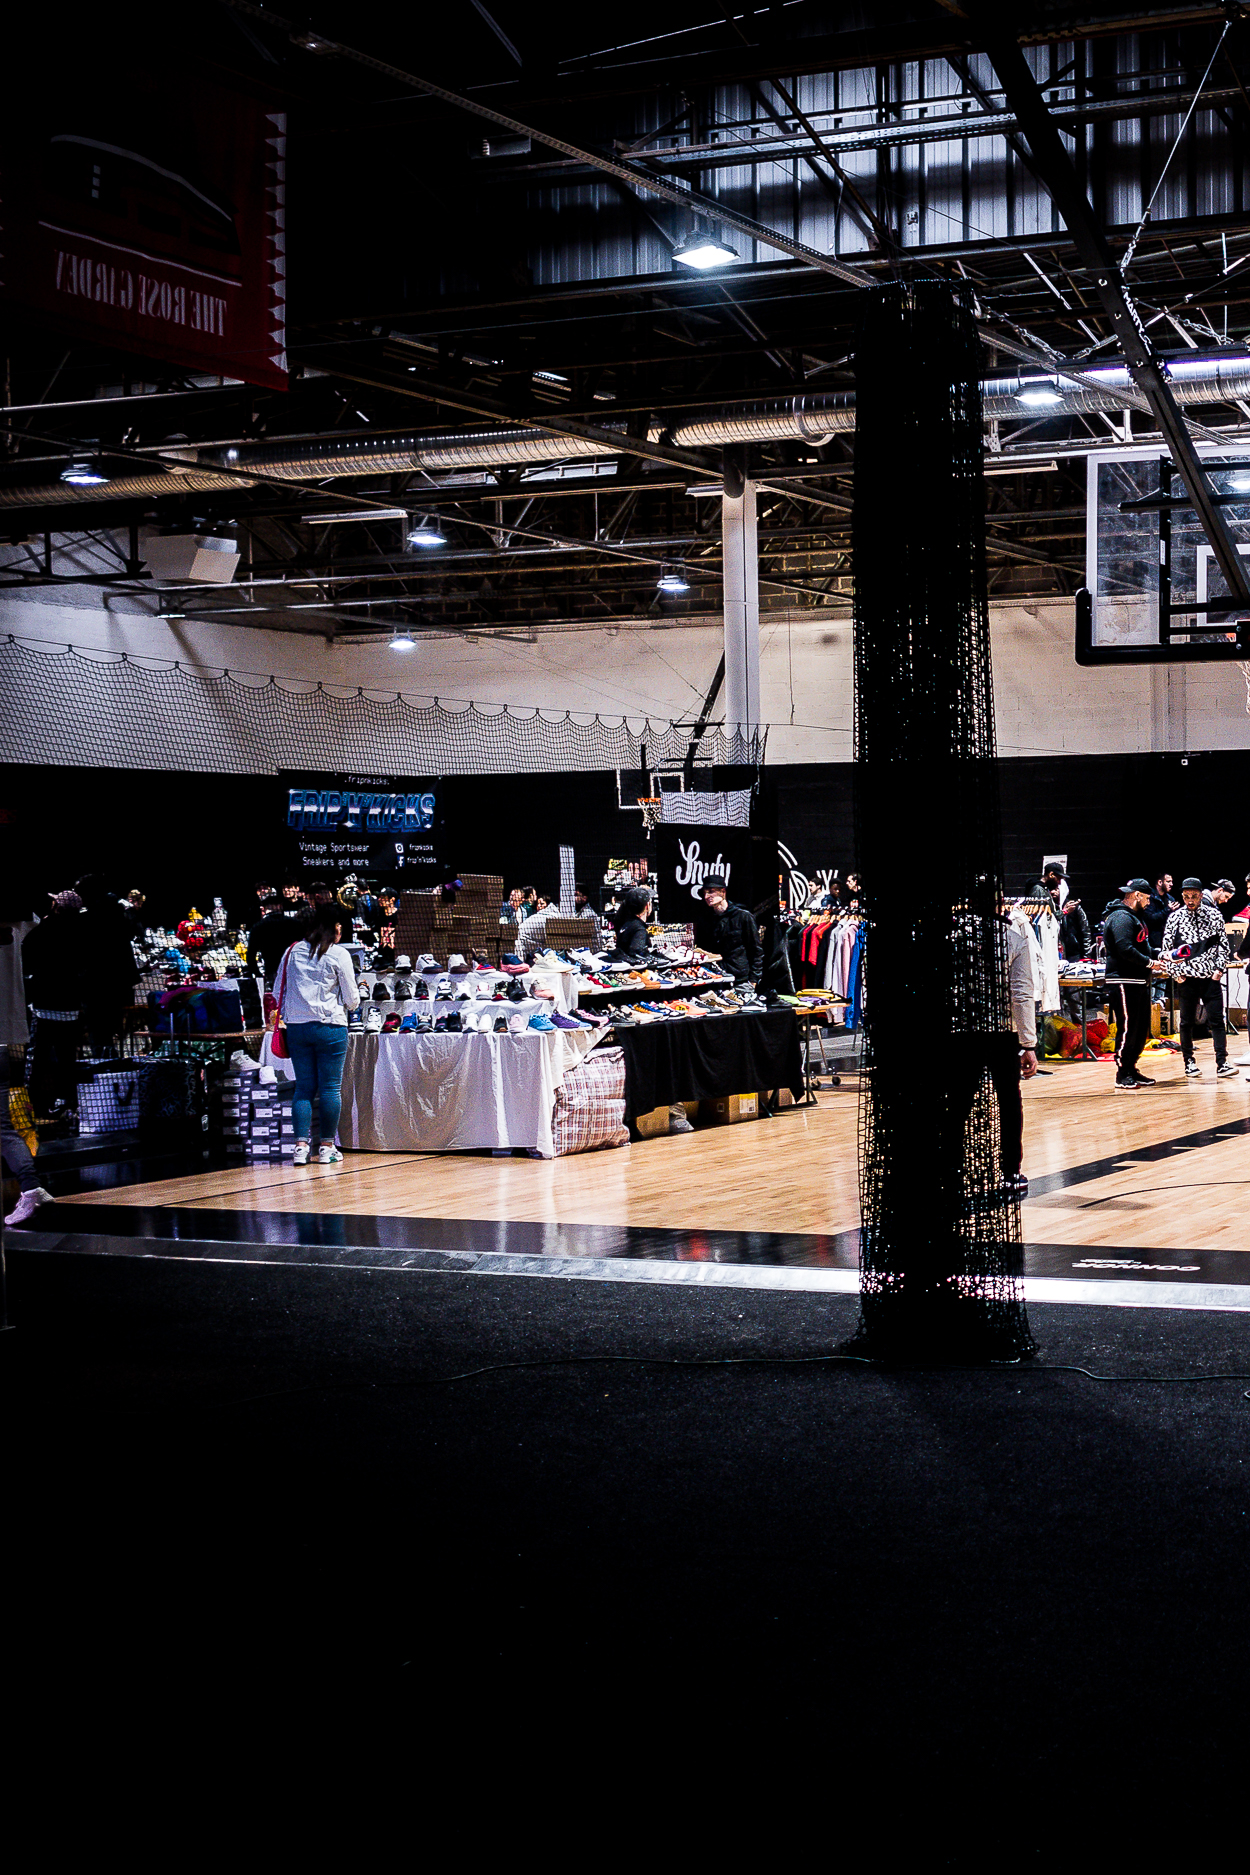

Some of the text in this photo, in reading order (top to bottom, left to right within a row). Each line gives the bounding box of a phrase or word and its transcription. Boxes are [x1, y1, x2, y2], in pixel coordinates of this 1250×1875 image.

[298, 841, 370, 854] Vintage Sportswear
[302, 856, 370, 866] Sneakers and more
[1071, 1262, 1201, 1272] CONNOR
